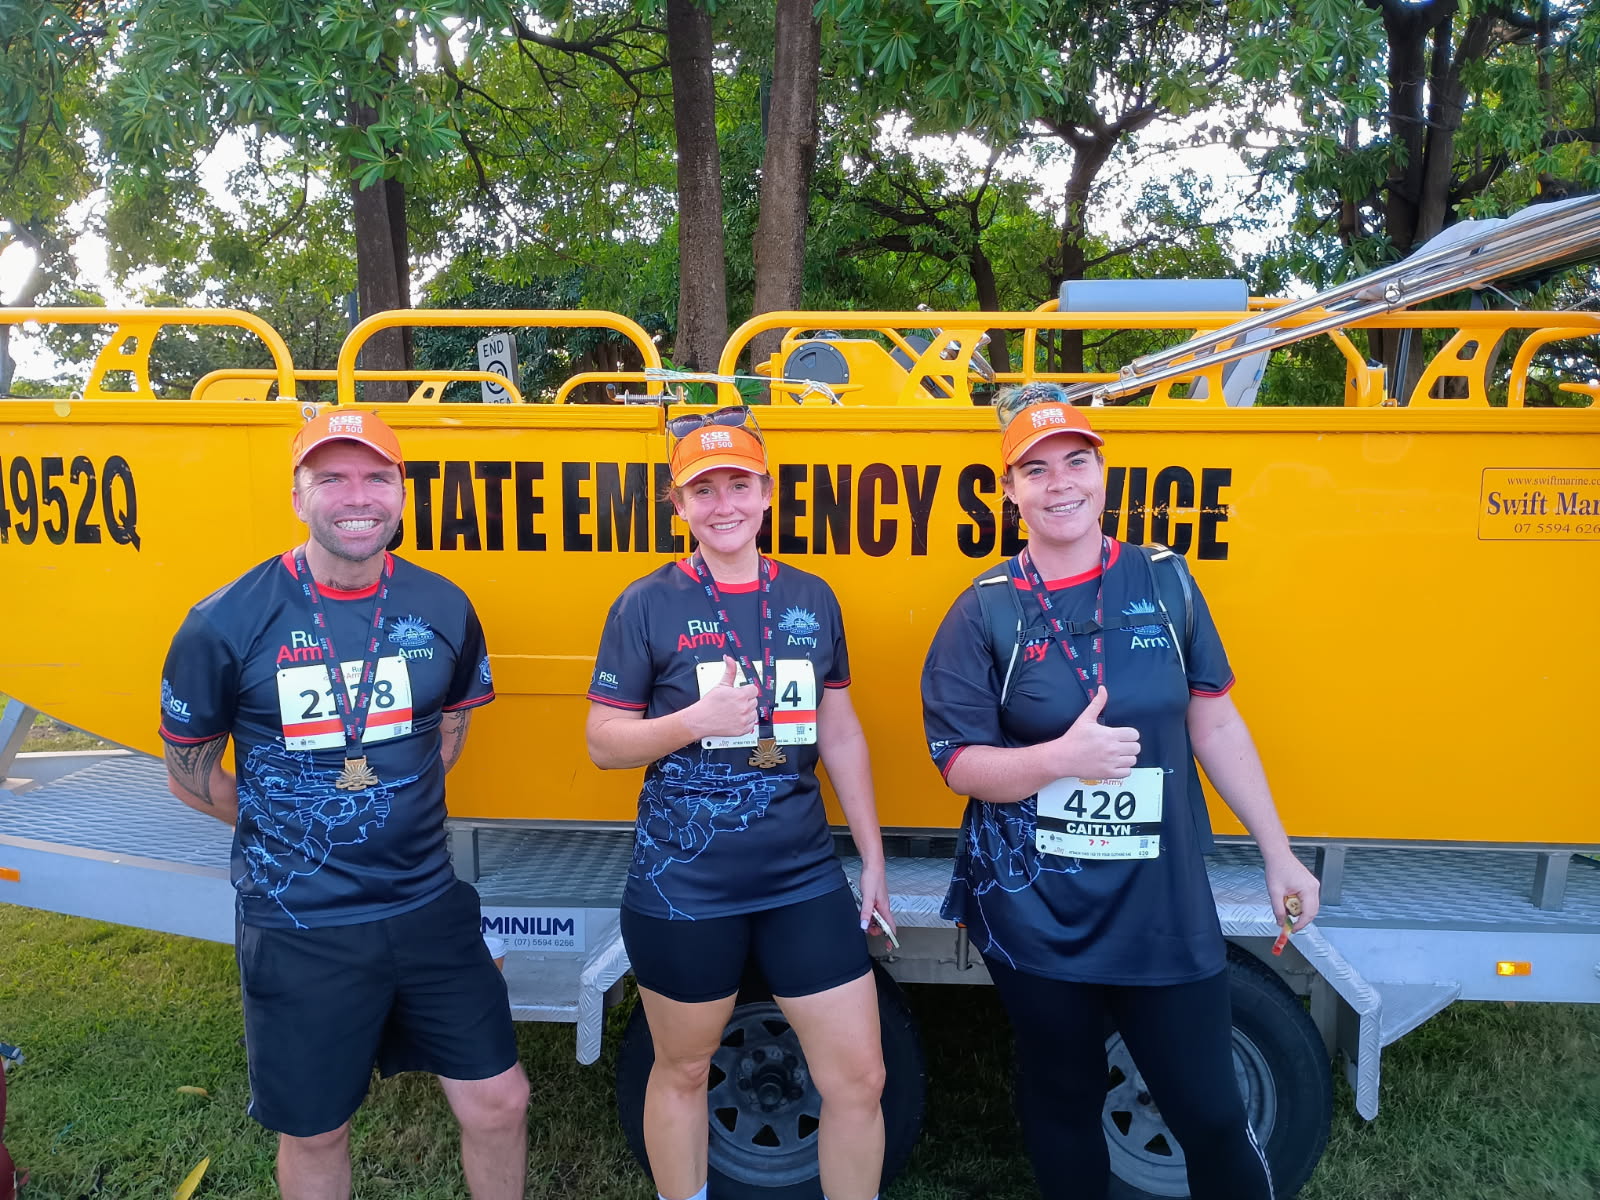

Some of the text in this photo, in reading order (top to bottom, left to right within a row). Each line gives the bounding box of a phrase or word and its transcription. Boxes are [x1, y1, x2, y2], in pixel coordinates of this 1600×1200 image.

[483, 340, 504, 358] END
[341, 415, 363, 425] SES
[1042, 408, 1064, 418] SES
[1049, 417, 1066, 425] 500
[328, 425, 363, 433] 132 500
[711, 431, 730, 441] SES
[702, 441, 733, 451] 132 500
[386, 461, 1232, 560] TATE EMEENCY SEVICE
[1487, 491, 1548, 516] Swift
[1514, 523, 1531, 534] 07
[1536, 523, 1570, 534] 5594
[291, 630, 320, 649] Ru
[677, 632, 726, 652] Army
[787, 634, 817, 649] Army
[1130, 635, 1170, 650] Arm
[276, 645, 323, 664] Arm
[398, 647, 434, 660] Army
[599, 671, 618, 685] RSL
[1063, 789, 1136, 820] 420
[1066, 822, 1131, 836] CAITLYN
[481, 916, 574, 936] MINIUM
[514, 938, 530, 948] (07)
[532, 938, 552, 946] 5594
[554, 939, 574, 947] 6266
